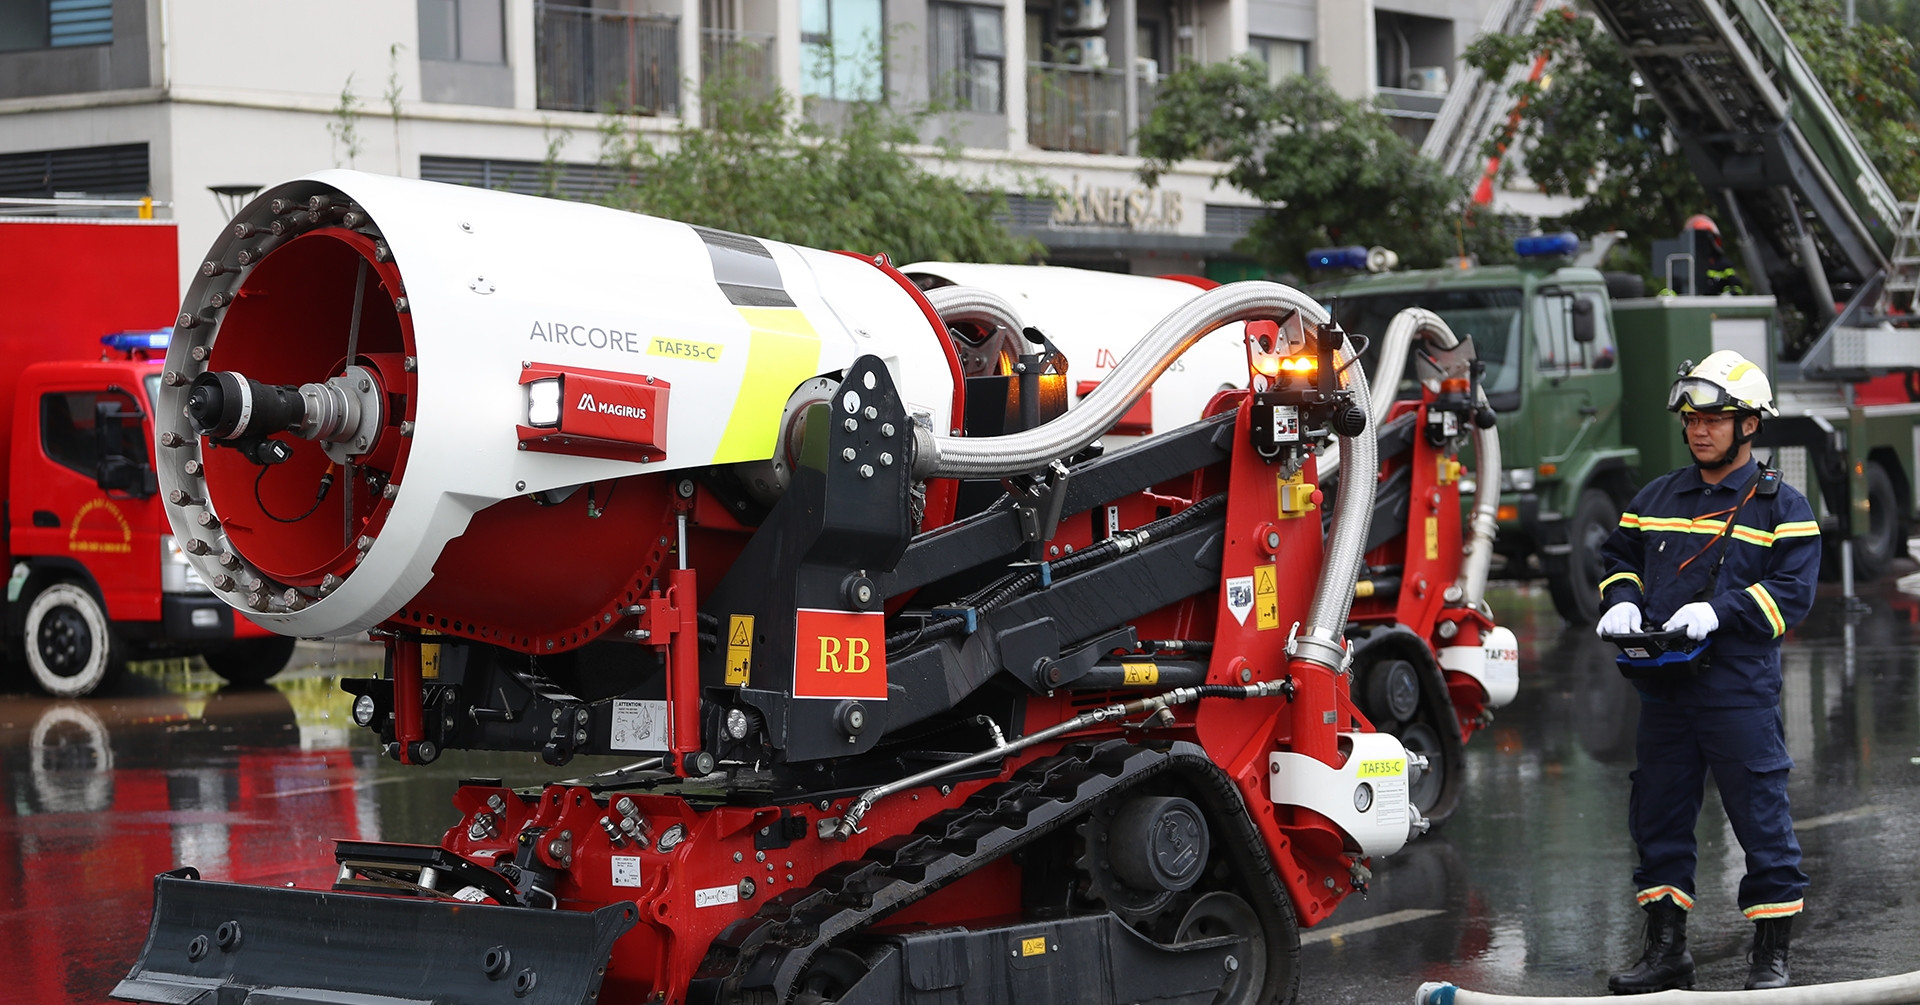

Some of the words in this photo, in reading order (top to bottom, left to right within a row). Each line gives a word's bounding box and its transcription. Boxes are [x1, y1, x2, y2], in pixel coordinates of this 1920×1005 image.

[530, 320, 639, 353] AIRCORE
[655, 340, 716, 360] TAF35-C
[598, 402, 647, 420] MAGIRUS
[816, 636, 871, 673] RB
[1485, 649, 1518, 661] TAF35
[1363, 761, 1401, 774] TAF35-C
